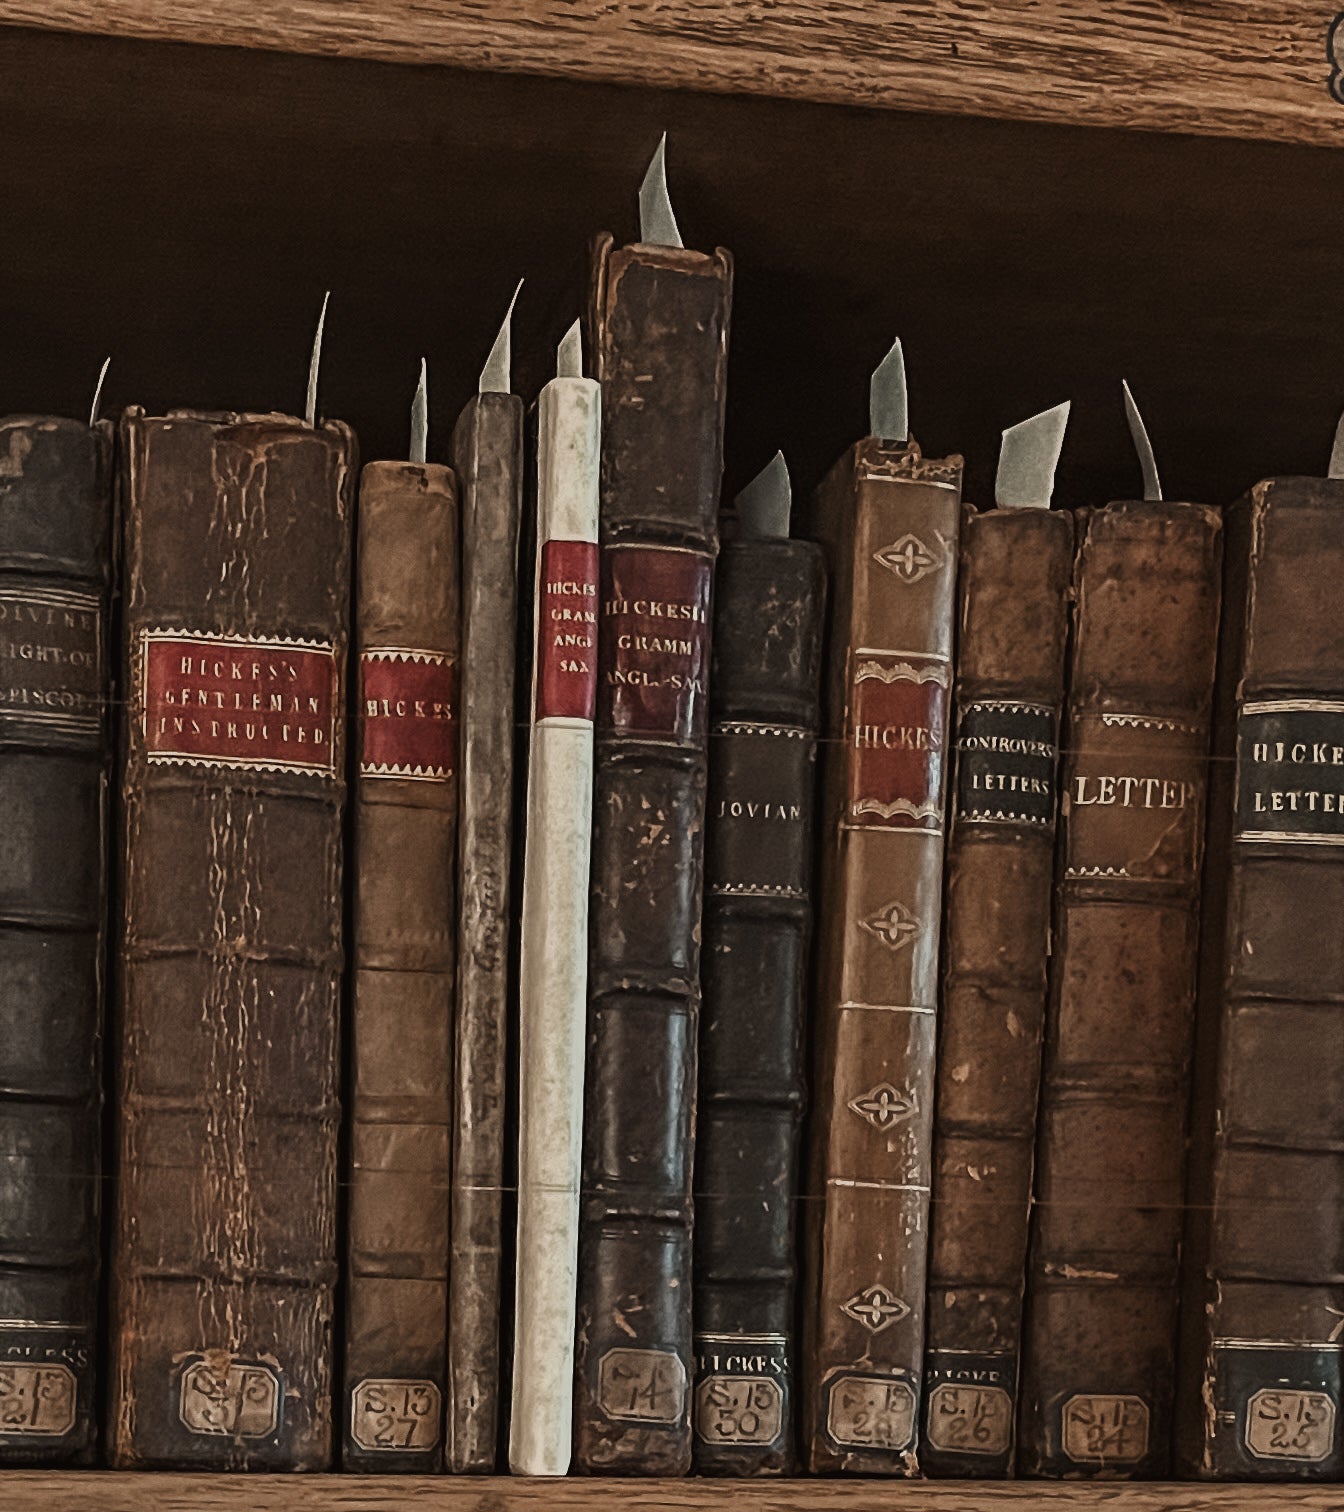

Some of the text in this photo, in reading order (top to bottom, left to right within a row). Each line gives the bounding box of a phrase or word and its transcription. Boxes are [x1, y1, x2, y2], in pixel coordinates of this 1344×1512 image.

[560, 659, 589, 673] SAX
[165, 686, 321, 715] GENTLEMAN
[366, 700, 454, 720] HICKES
[855, 723, 941, 749] HICKES
[972, 773, 1049, 796] LETTERS
[716, 800, 802, 822] JOVIAN
[374, 1417, 419, 1449] 27
